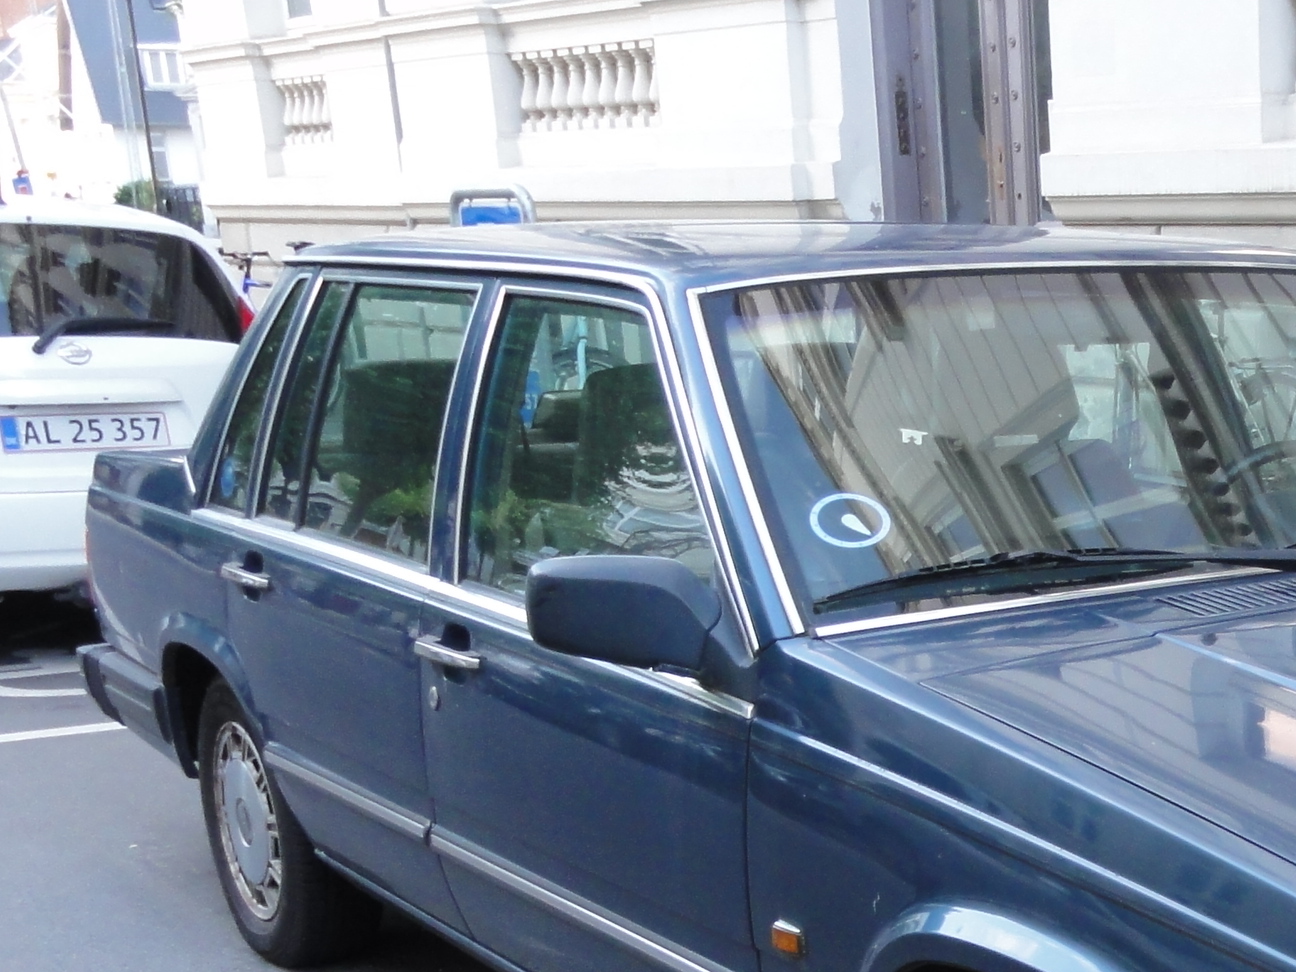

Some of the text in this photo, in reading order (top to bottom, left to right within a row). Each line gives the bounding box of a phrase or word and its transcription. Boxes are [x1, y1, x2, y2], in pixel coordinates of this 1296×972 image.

[24, 420, 61, 444] AL
[69, 419, 104, 443] 25
[110, 417, 161, 442] 357
